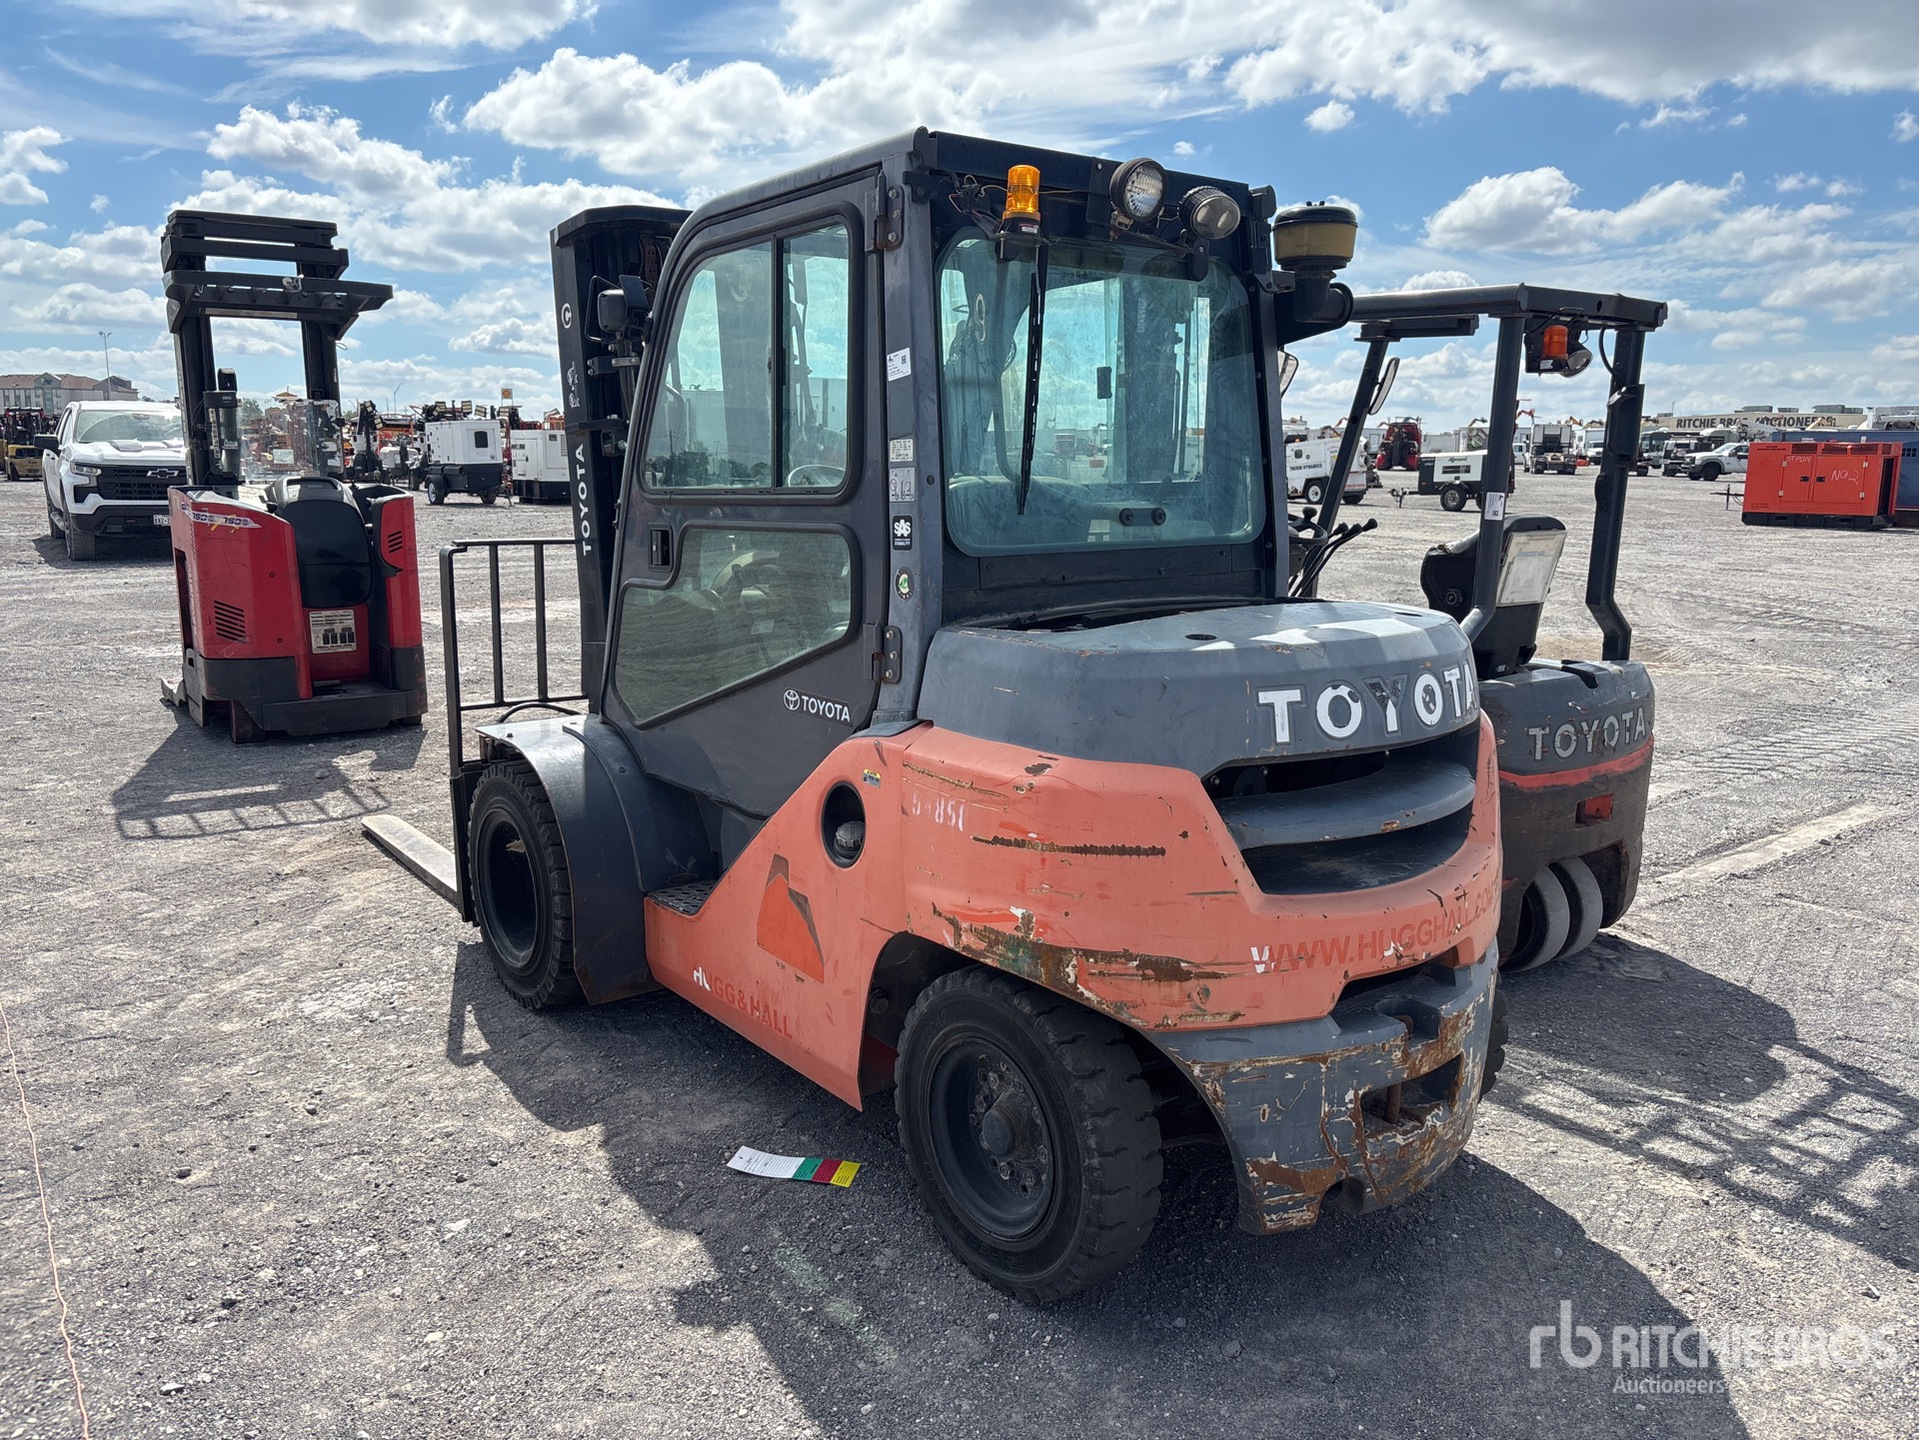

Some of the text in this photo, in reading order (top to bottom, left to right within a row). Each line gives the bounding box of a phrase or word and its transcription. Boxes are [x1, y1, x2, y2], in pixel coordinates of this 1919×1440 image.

[1676, 418, 1716, 429] RITCHIE
[575, 443, 591, 556] TOYOTA
[894, 519, 911, 537] SAS
[801, 695, 851, 723] TOYOTA
[1258, 662, 1478, 743] TOYOTA
[1529, 707, 1647, 760] TOYOTA
[693, 966, 793, 1040] HUGG&HALL
